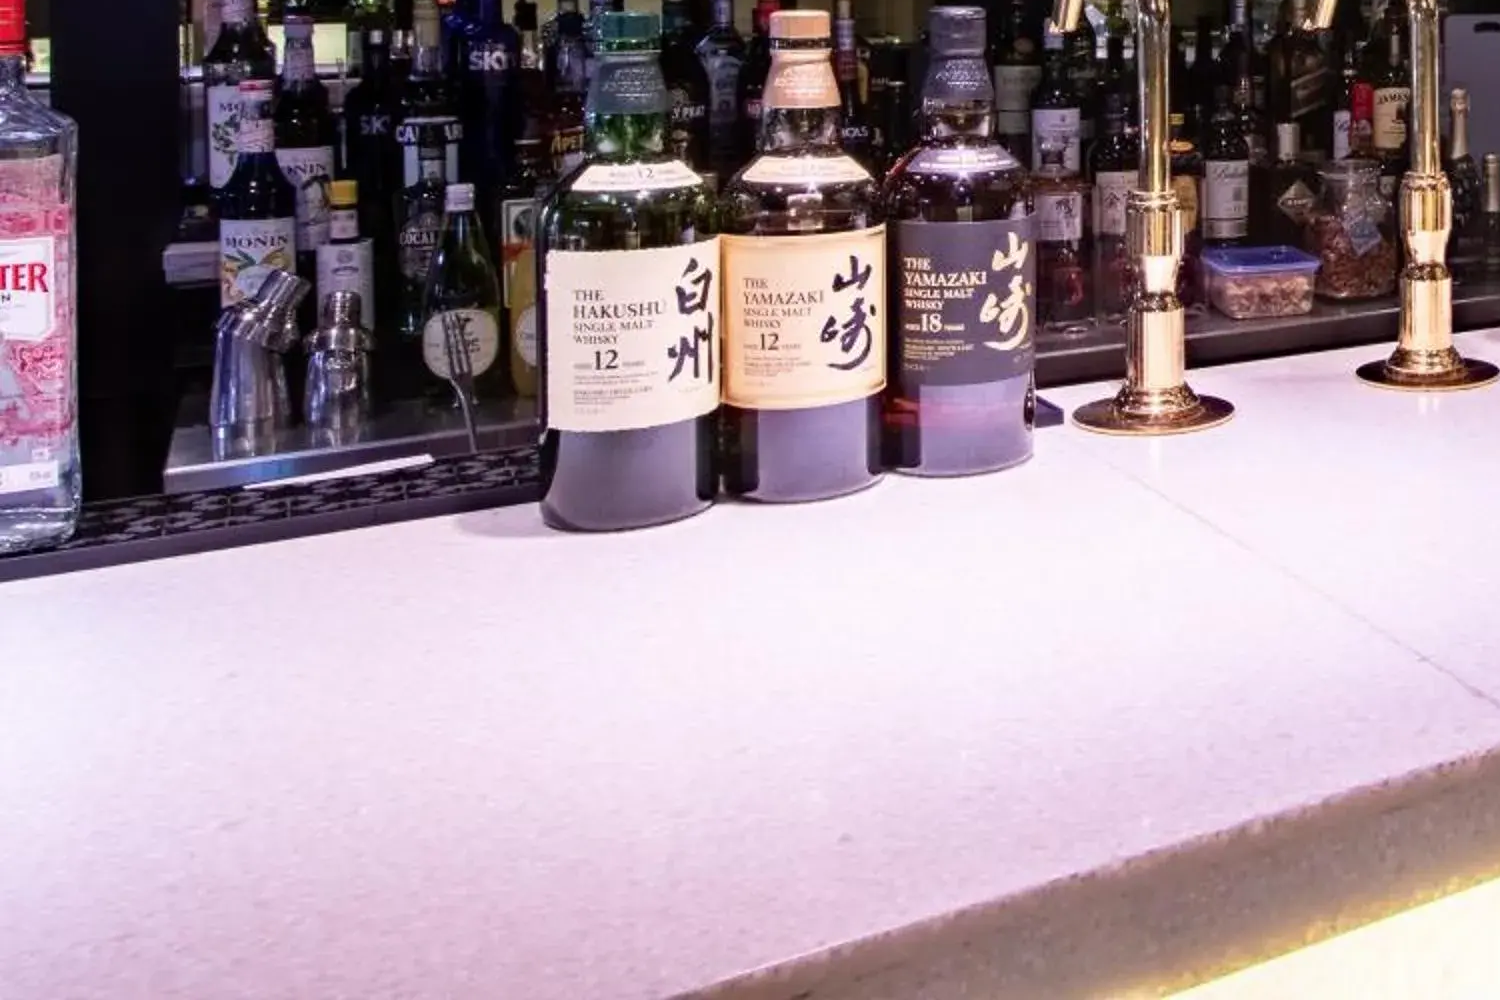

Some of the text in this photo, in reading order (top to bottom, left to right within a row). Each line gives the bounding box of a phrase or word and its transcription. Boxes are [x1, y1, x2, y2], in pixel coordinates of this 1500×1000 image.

[284, 162, 327, 175] ONIN
[225, 235, 289, 249] MONIN
[904, 257, 931, 270] THE
[743, 278, 769, 289] THE
[904, 271, 987, 286] YAMAZAKI
[573, 289, 605, 301] THE
[743, 290, 825, 305] YAMAZAKI
[904, 287, 975, 299] SINGLE MALT
[573, 300, 668, 320] HAKUSHU
[904, 300, 945, 311] WHISKY
[743, 307, 812, 318] SINGLE MALT
[573, 319, 655, 333] SINGLE MALT
[667, 257, 714, 384] 白州
[743, 318, 781, 329] WHISKY
[920, 313, 942, 333] 18
[573, 334, 618, 345] WHISKY
[759, 333, 780, 351] 12
[594, 349, 619, 370] 12
